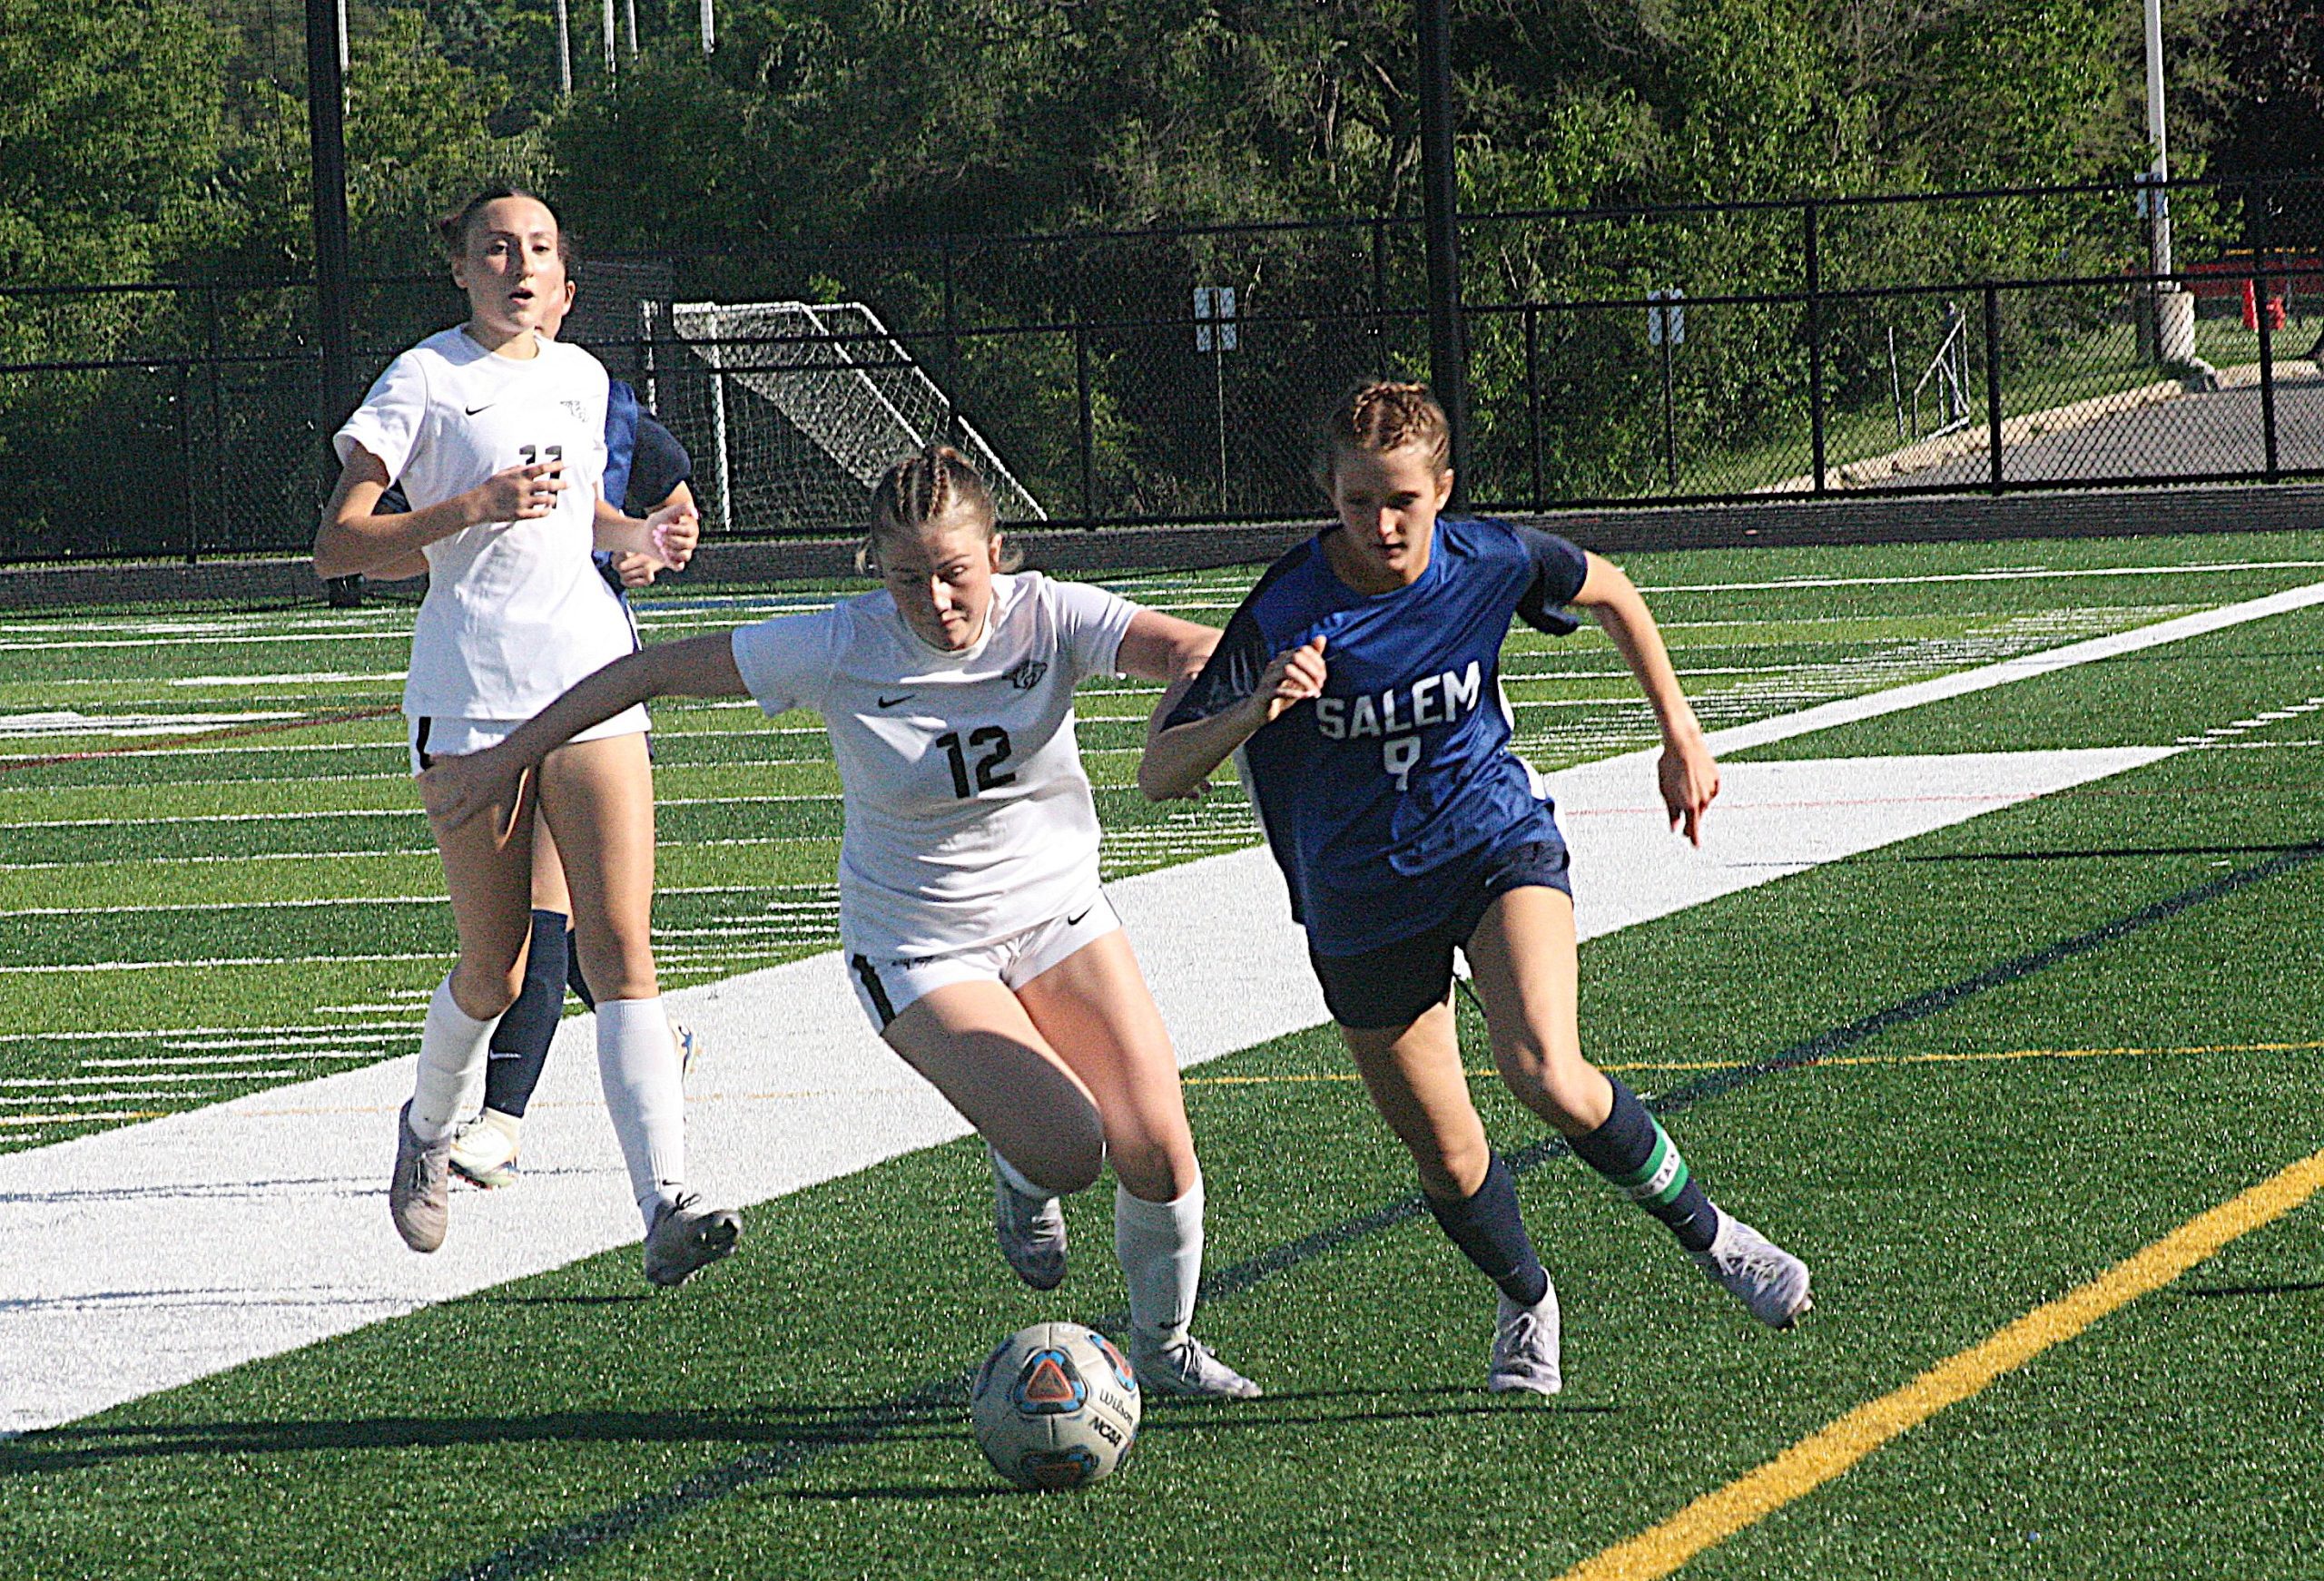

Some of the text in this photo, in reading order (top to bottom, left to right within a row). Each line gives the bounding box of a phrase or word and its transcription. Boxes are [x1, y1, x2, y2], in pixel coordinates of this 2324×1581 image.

[1316, 660, 1482, 740] SALEM
[935, 725, 1017, 799] 12
[1383, 735, 1422, 791] 9
[1088, 1416, 1122, 1448] NCAA
[1099, 1389, 1134, 1427] Wilson
